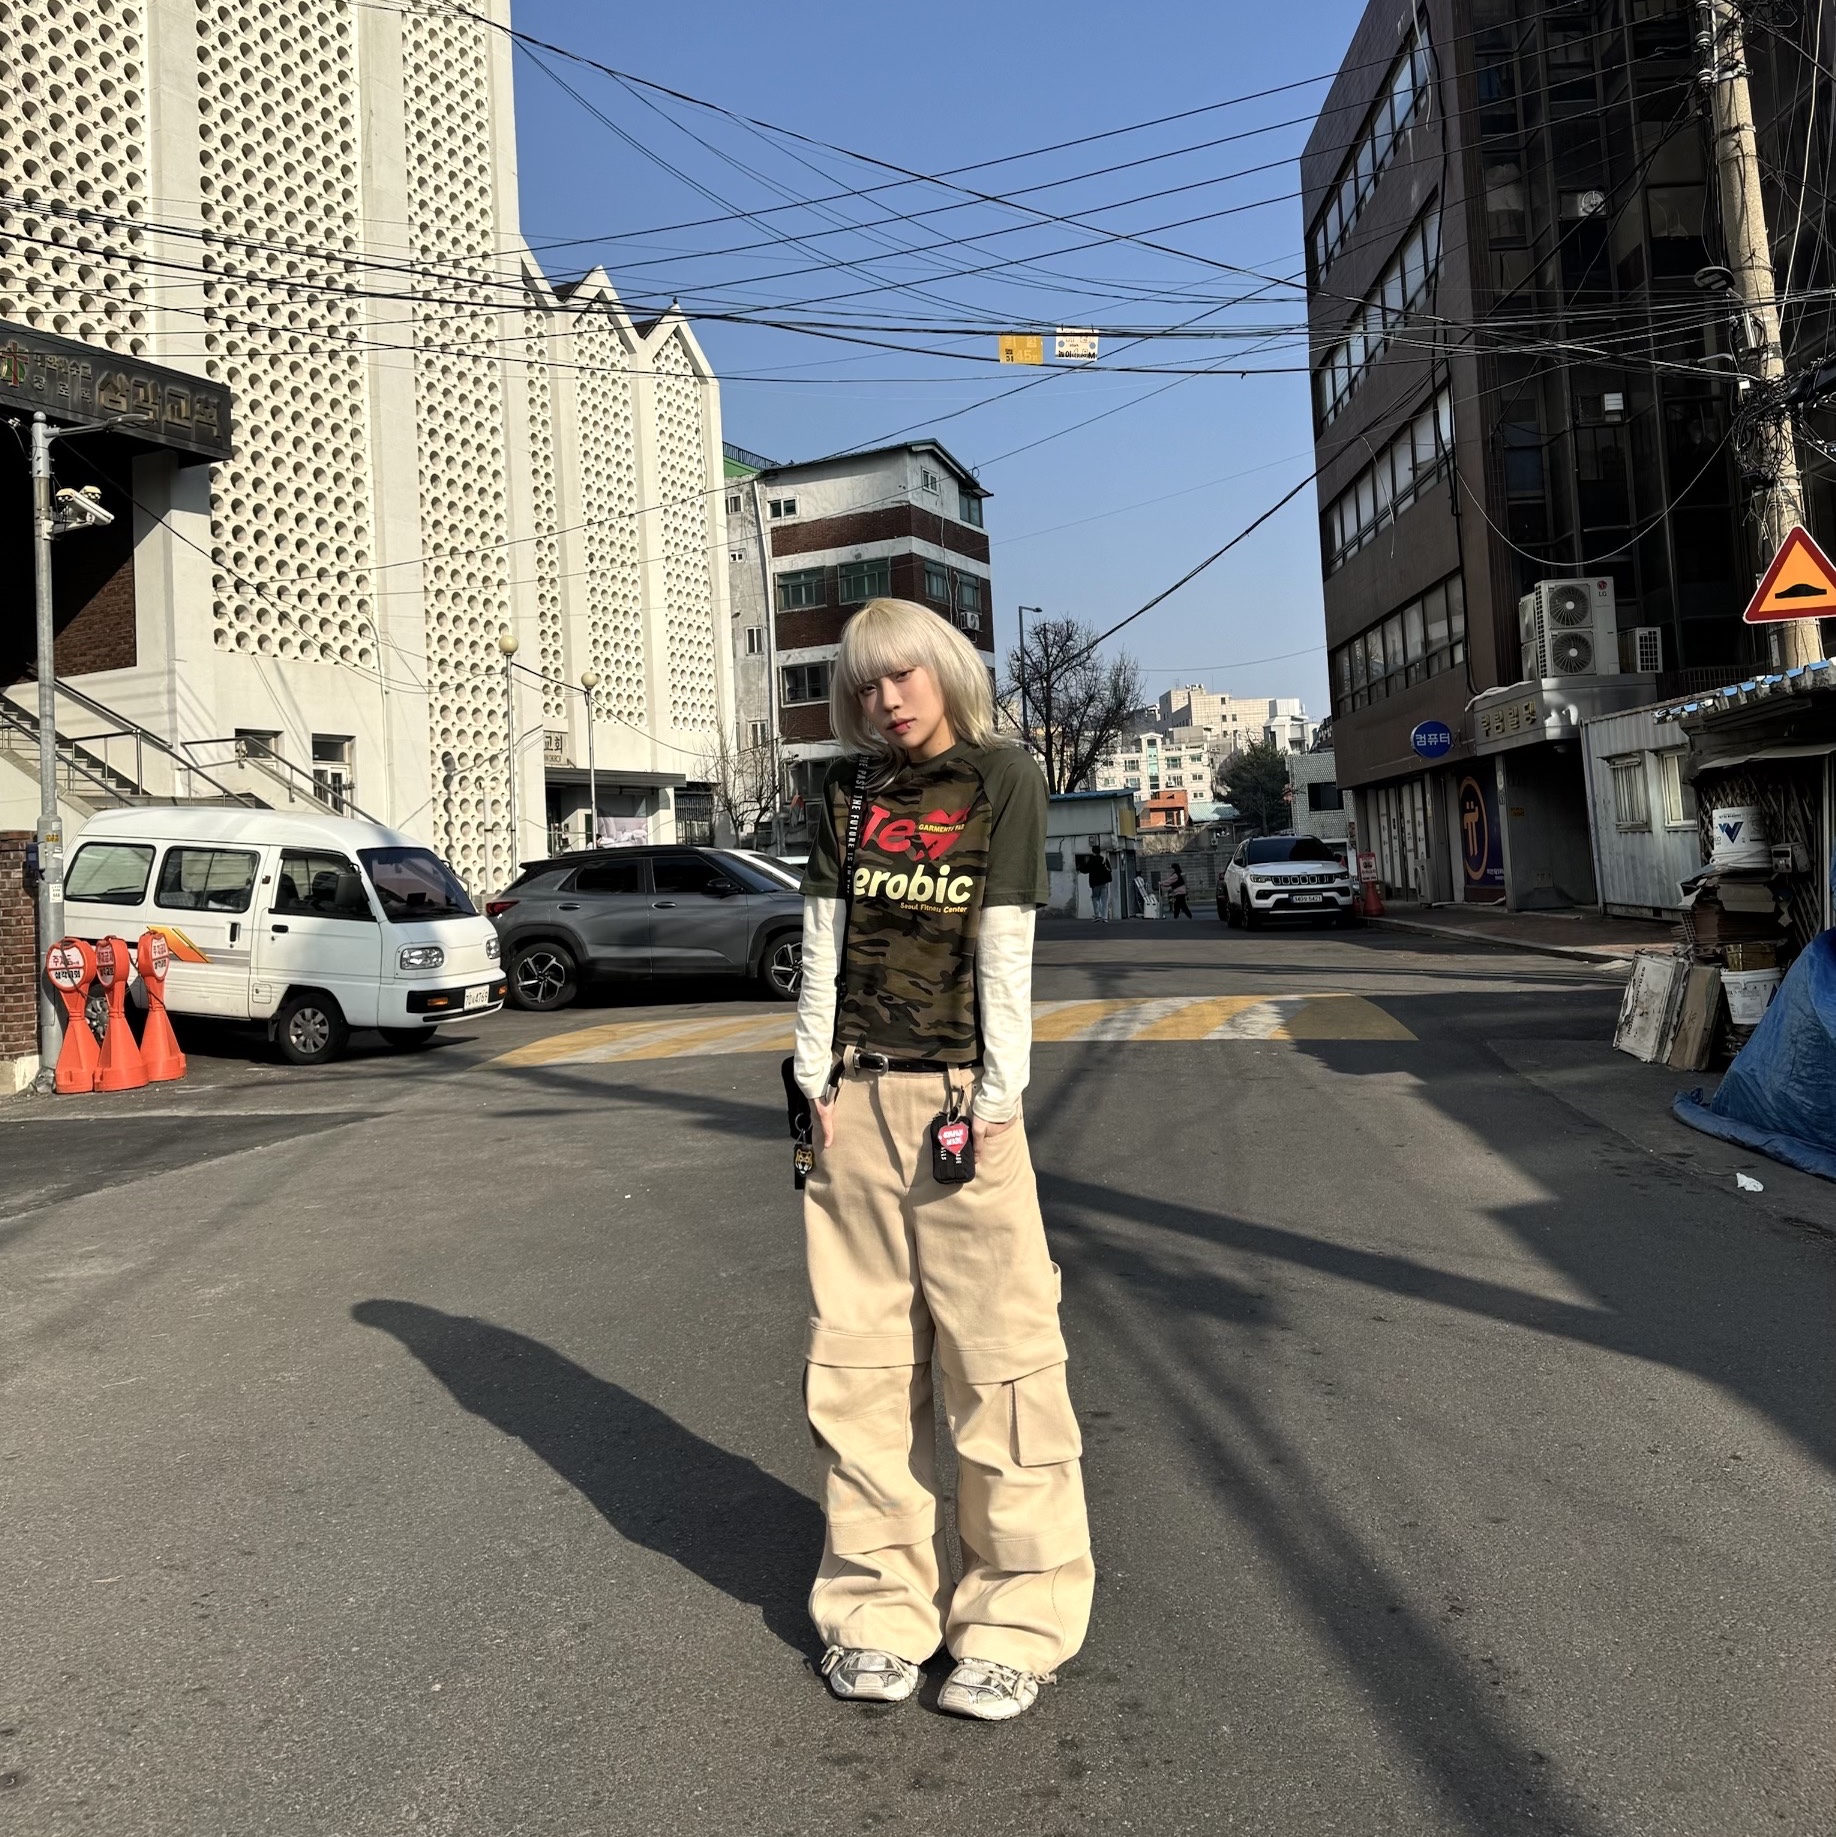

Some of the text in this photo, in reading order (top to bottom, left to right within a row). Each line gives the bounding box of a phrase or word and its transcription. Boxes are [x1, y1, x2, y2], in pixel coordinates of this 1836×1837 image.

[1415, 732, 1451, 747] 컴퓨터
[851, 795, 863, 810] THE
[847, 814, 859, 848] FUTURE
[900, 902, 918, 910] Seoul
[920, 904, 941, 912] Fitness
